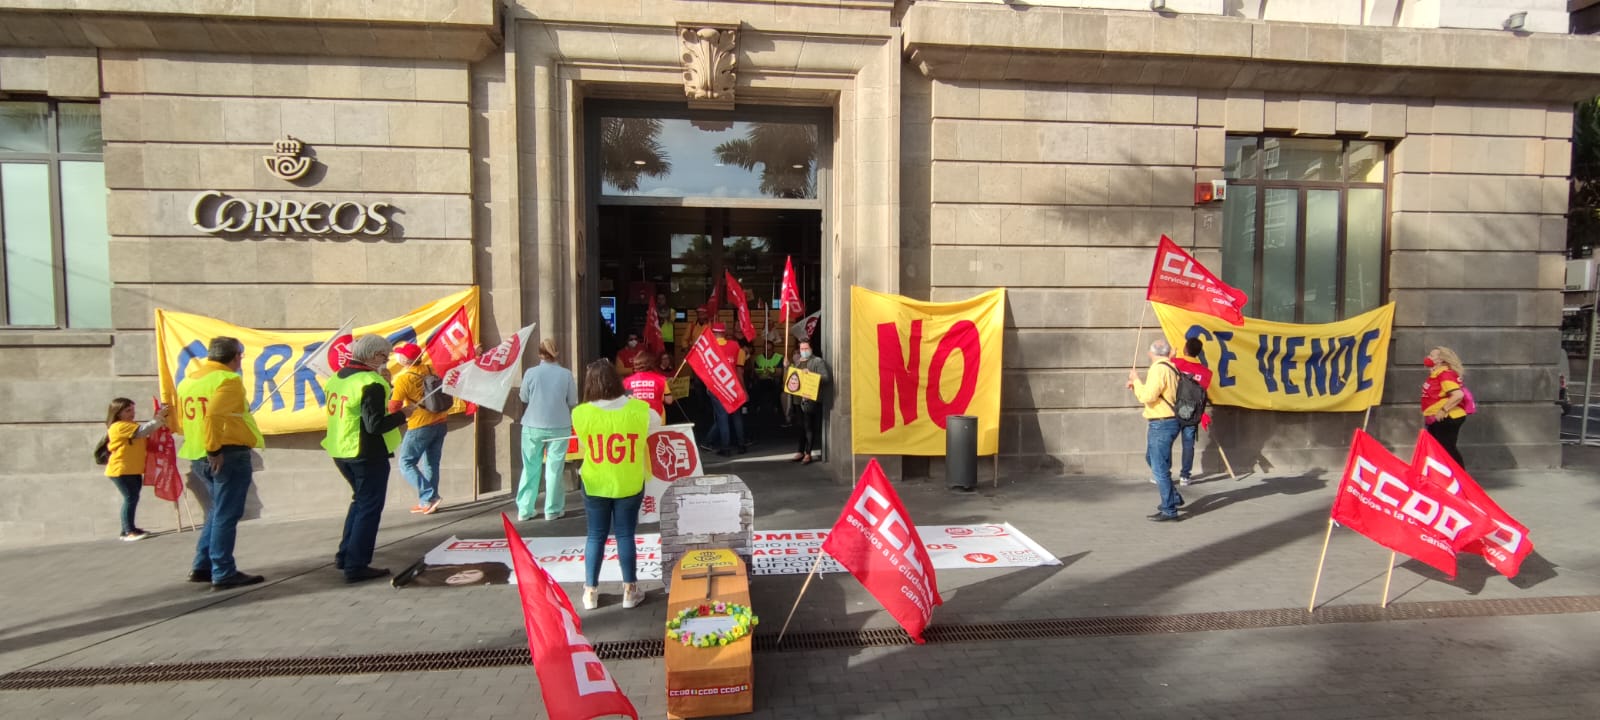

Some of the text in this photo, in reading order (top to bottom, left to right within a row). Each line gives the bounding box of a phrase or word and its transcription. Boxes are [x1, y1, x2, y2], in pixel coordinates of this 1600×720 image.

[189, 190, 388, 234] CORREOS
[877, 319, 981, 433] NO
[1257, 328, 1380, 397] VENDE
[587, 432, 639, 464] UGT
[671, 439, 690, 470] UGT
[1351, 455, 1472, 540] CCOO
[846, 514, 883, 550] servicios
